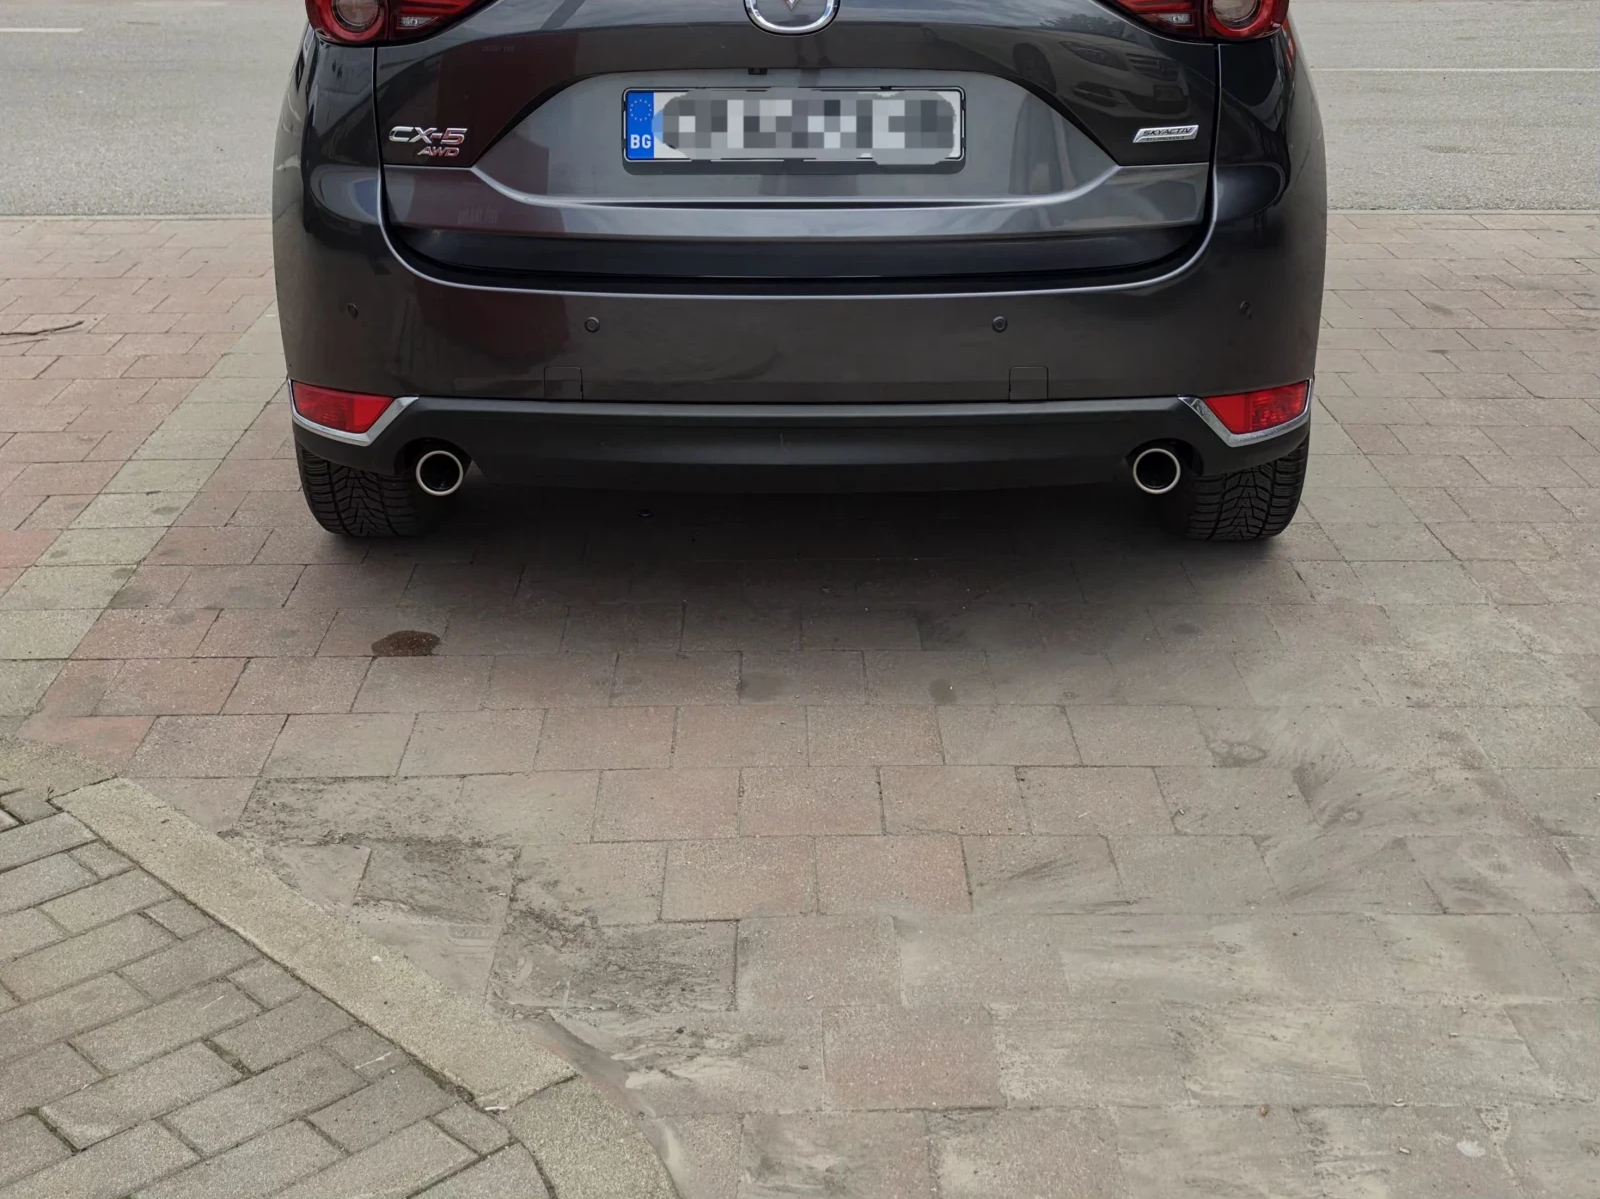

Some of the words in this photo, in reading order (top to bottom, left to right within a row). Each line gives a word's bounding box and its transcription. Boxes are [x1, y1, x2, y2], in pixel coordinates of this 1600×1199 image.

[388, 125, 468, 145] CX-5
[1143, 128, 1192, 136] SKYACTIV
[630, 134, 652, 149] BG
[417, 146, 460, 157] AWD
